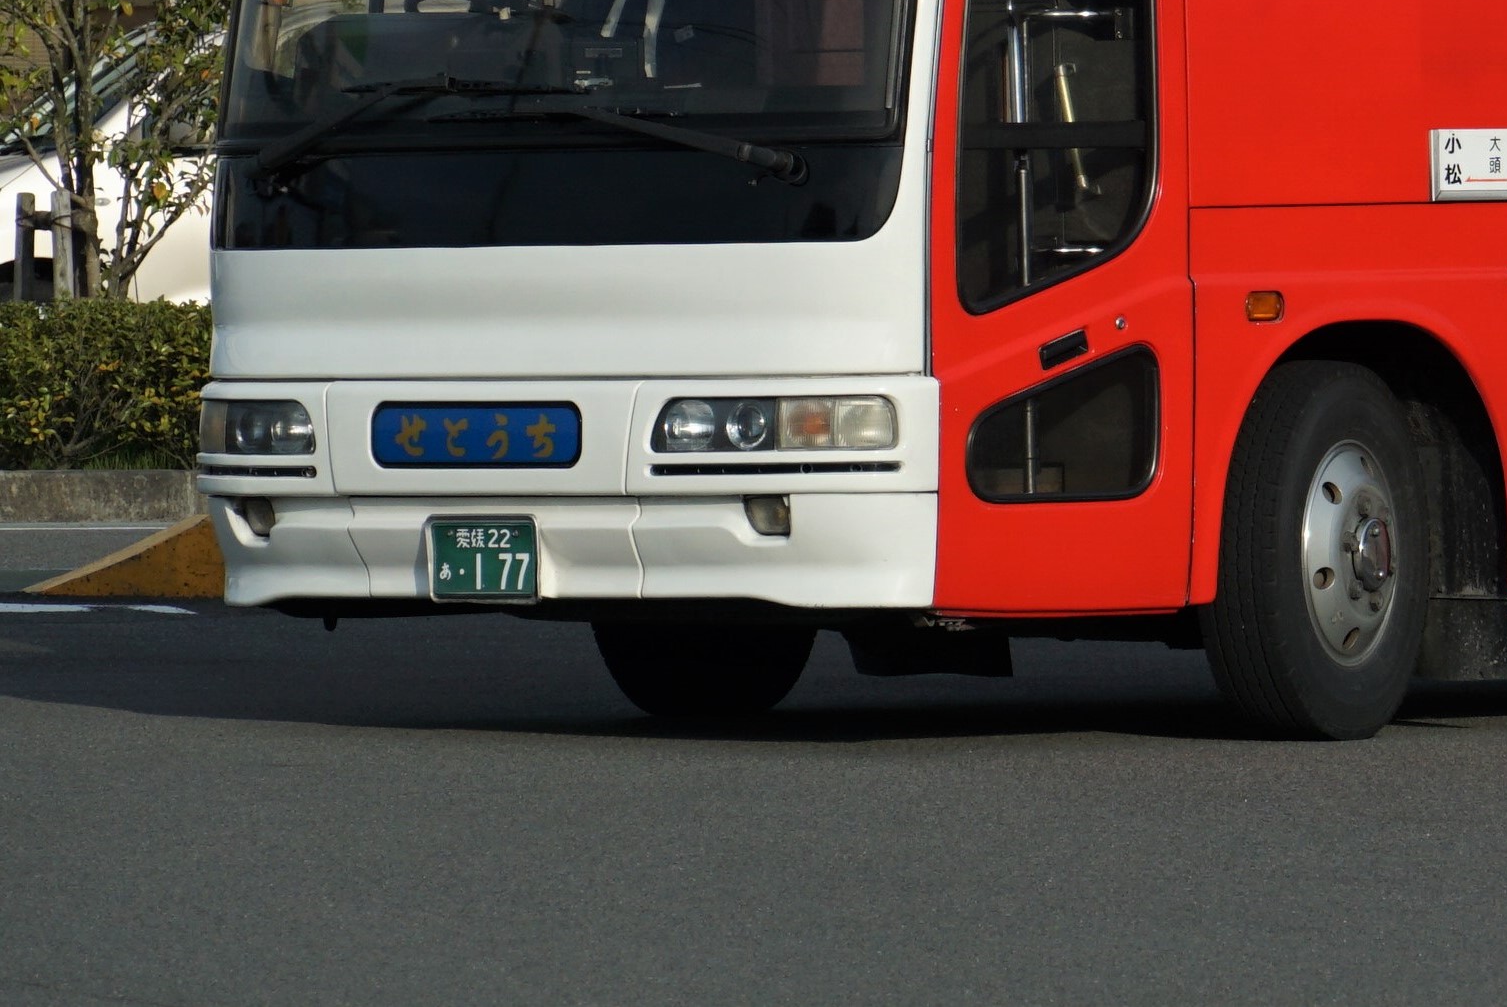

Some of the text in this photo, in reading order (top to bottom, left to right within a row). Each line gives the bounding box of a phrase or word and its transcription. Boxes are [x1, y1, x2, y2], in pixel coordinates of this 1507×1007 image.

[1444, 132, 1463, 185] 小松
[1488, 135, 1502, 174] 大頭
[394, 413, 557, 460] せとうち
[439, 562, 452, 581] あ
